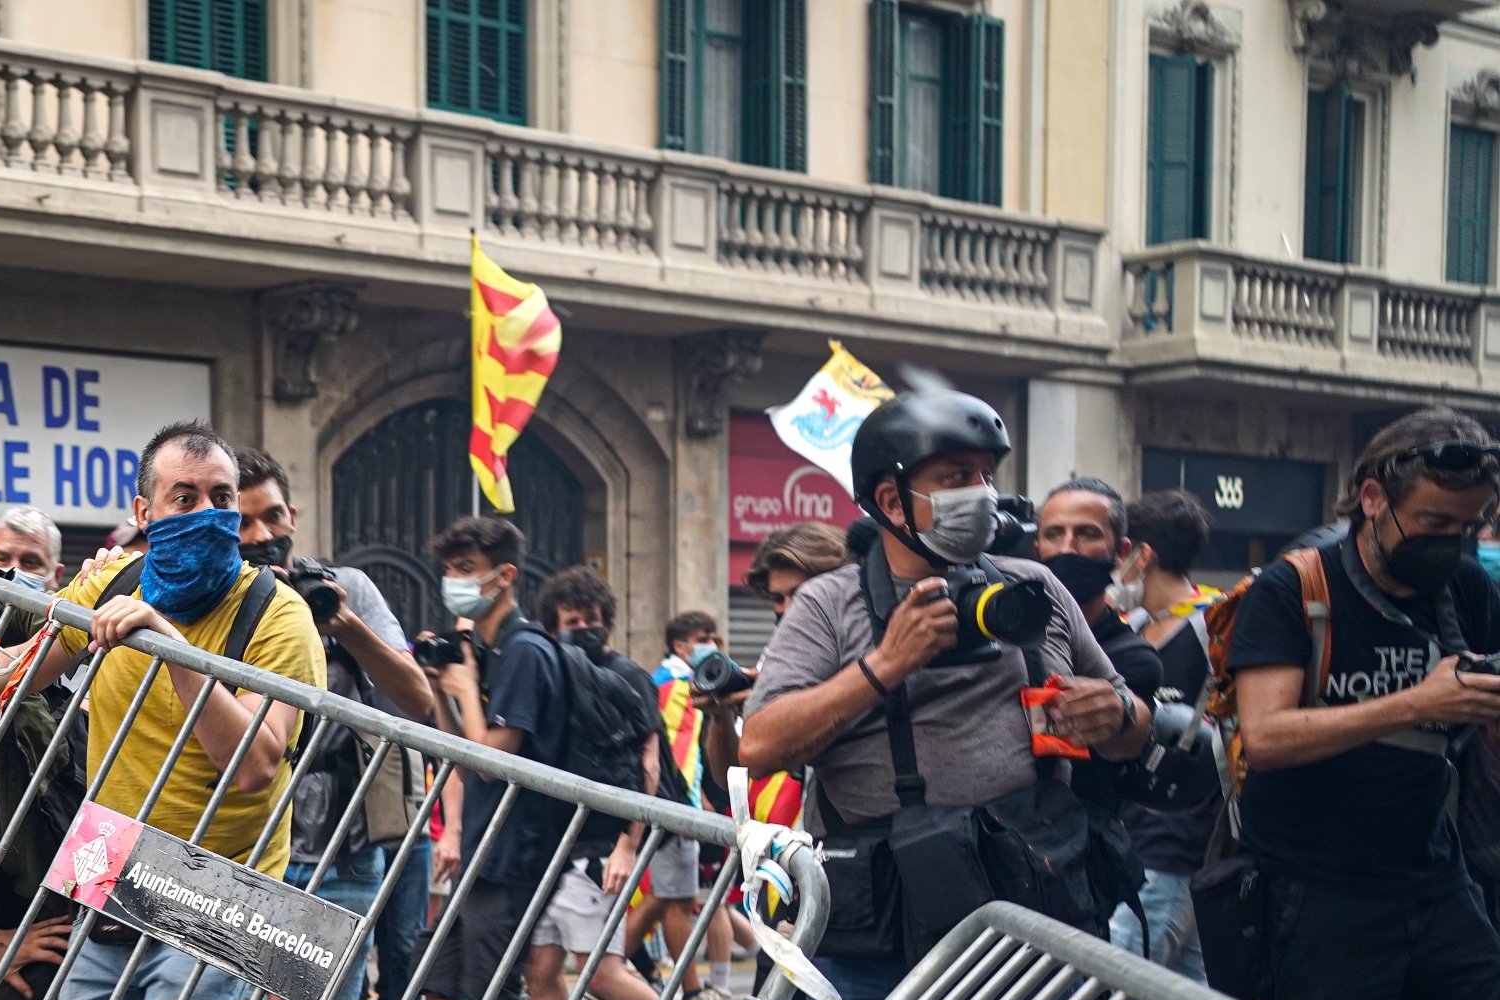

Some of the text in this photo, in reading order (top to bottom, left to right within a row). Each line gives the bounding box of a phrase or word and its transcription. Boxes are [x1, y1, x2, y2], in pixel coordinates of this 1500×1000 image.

[41, 366, 101, 433] DE
[54, 444, 140, 511] HOR
[733, 482, 834, 519] grupo hna
[1214, 474, 1244, 510] 365
[1374, 646, 1424, 679] THE
[126, 860, 335, 970] Ajuntament de Barcelona
